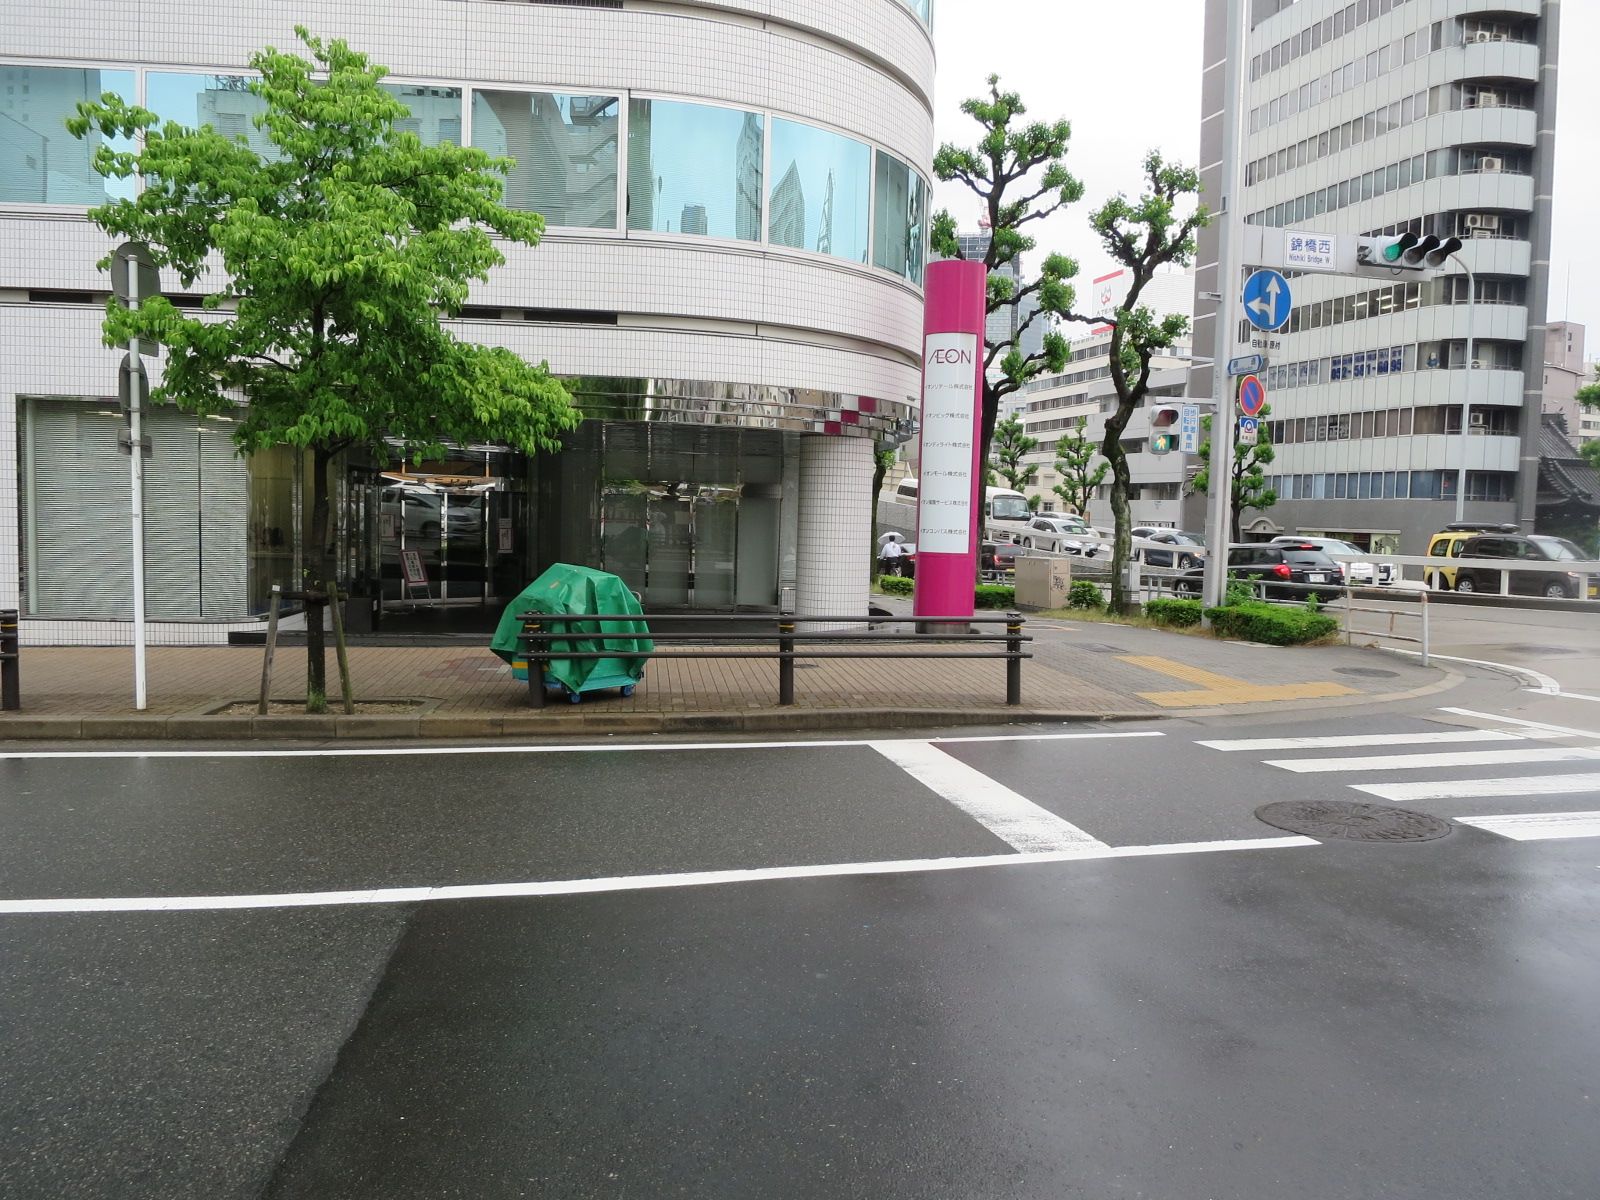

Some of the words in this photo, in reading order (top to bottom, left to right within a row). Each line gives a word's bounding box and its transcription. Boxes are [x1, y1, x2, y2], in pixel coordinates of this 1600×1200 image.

[1291, 237, 1331, 254] 錦橋西
[1289, 254, 1305, 262] Nishiki
[1307, 255, 1322, 264] Bridge
